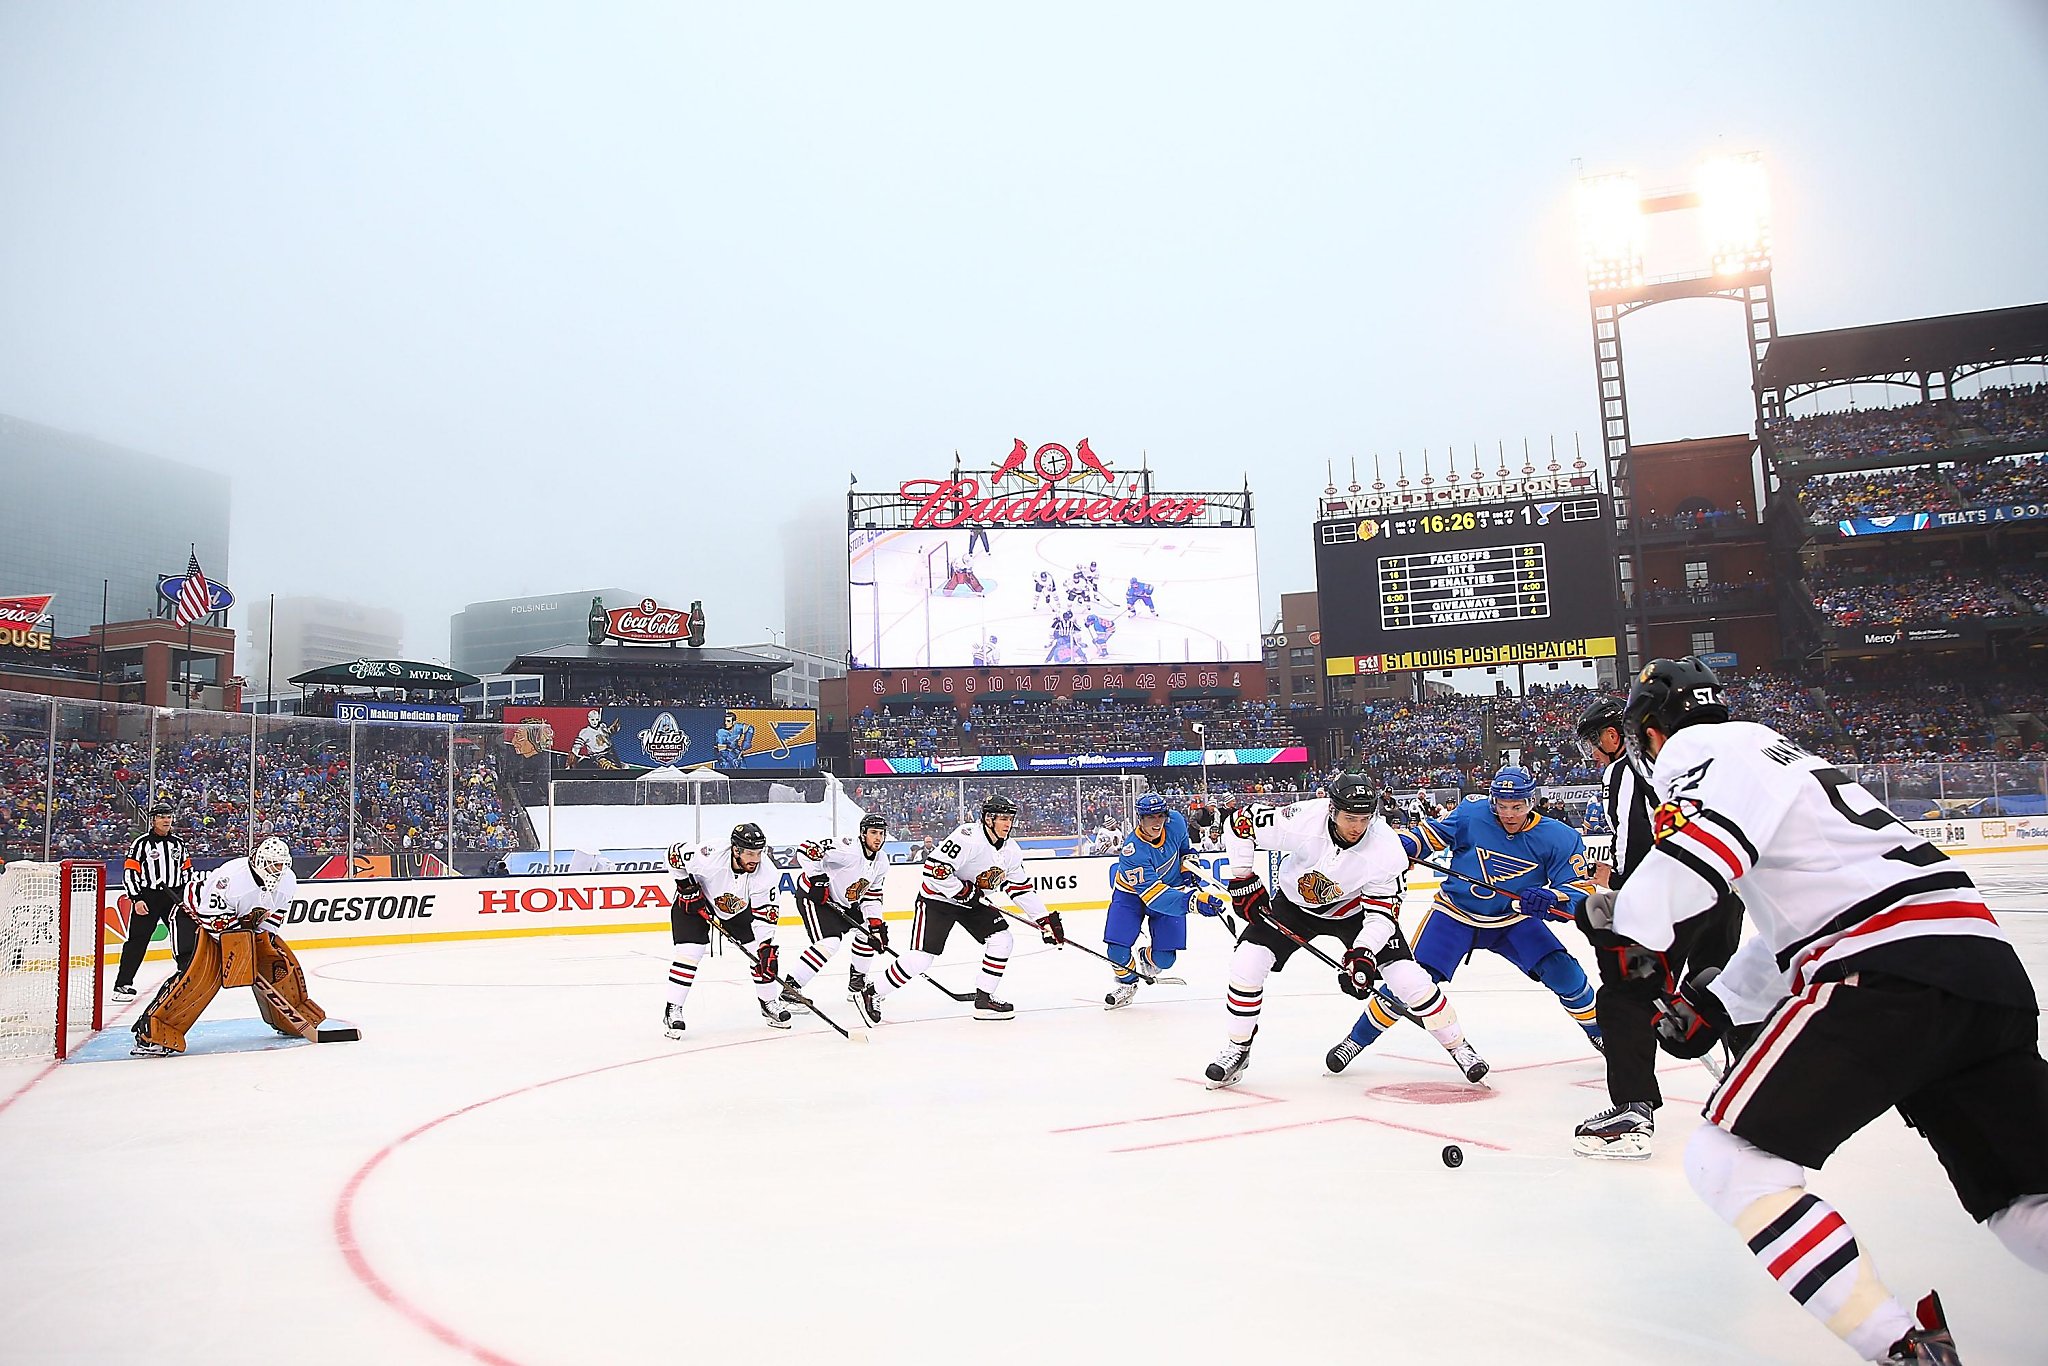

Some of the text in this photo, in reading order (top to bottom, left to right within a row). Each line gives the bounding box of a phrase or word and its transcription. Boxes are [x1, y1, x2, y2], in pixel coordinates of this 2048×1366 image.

[1345, 478, 1571, 511] WORLD CHAMPIONS
[900, 479, 1206, 528] Budweiser
[1504, 509, 1514, 517] 27
[1521, 505, 1532, 524] 1
[1938, 510, 1987, 525] THAT'S
[1994, 508, 2005, 520] A
[1380, 520, 1391, 538] 1
[1420, 512, 1475, 533] 16:26
[1480, 519, 1488, 528] 3
[1430, 551, 1490, 564] FACEOFFS
[1523, 547, 1533, 555] 22
[1447, 564, 1476, 575] HITS
[1430, 575, 1494, 588] PENALTIES
[1386, 583, 1540, 602] 6:00 PIM 4:00
[511, 602, 558, 614] POLSINELLI
[1432, 598, 1496, 611] GIVEAWAYS
[1430, 610, 1500, 623] TAKEAWAYS
[1865, 633, 1896, 645] Mercy
[1386, 639, 1586, 669] ST. LOUIS POST-DISPATCH
[409, 670, 453, 681] MVP Deck
[1015, 675, 1032, 691] 14
[1043, 675, 1060, 691] 17
[1072, 674, 1092, 690] 20
[1103, 673, 1124, 689] 24
[1135, 673, 1155, 688] 42
[1167, 672, 1187, 688] 45
[1198, 672, 1218, 687] 85
[901, 677, 908, 693] 1
[919, 677, 931, 693] 2
[942, 677, 954, 692] 6
[965, 676, 976, 692] 9
[988, 676, 1003, 692] 10
[1693, 687, 1716, 705] 57
[340, 706, 459, 722] BJC Making Medicine Better
[638, 729, 690, 748] Winter
[1355, 785, 1366, 795] 15
[1501, 780, 1514, 788] 26
[1955, 826, 1965, 840] 88
[2016, 828, 2031, 839] Mini
[940, 839, 962, 859] 88
[1125, 866, 1146, 886] 57
[1270, 851, 1281, 893] Reebok
[1034, 875, 1078, 891] INGS
[478, 885, 673, 915] HONDA
[769, 886, 776, 902] 6
[287, 894, 436, 924] DGESTONE
[223, 951, 235, 979] CCM
[163, 976, 191, 1011] CCM
